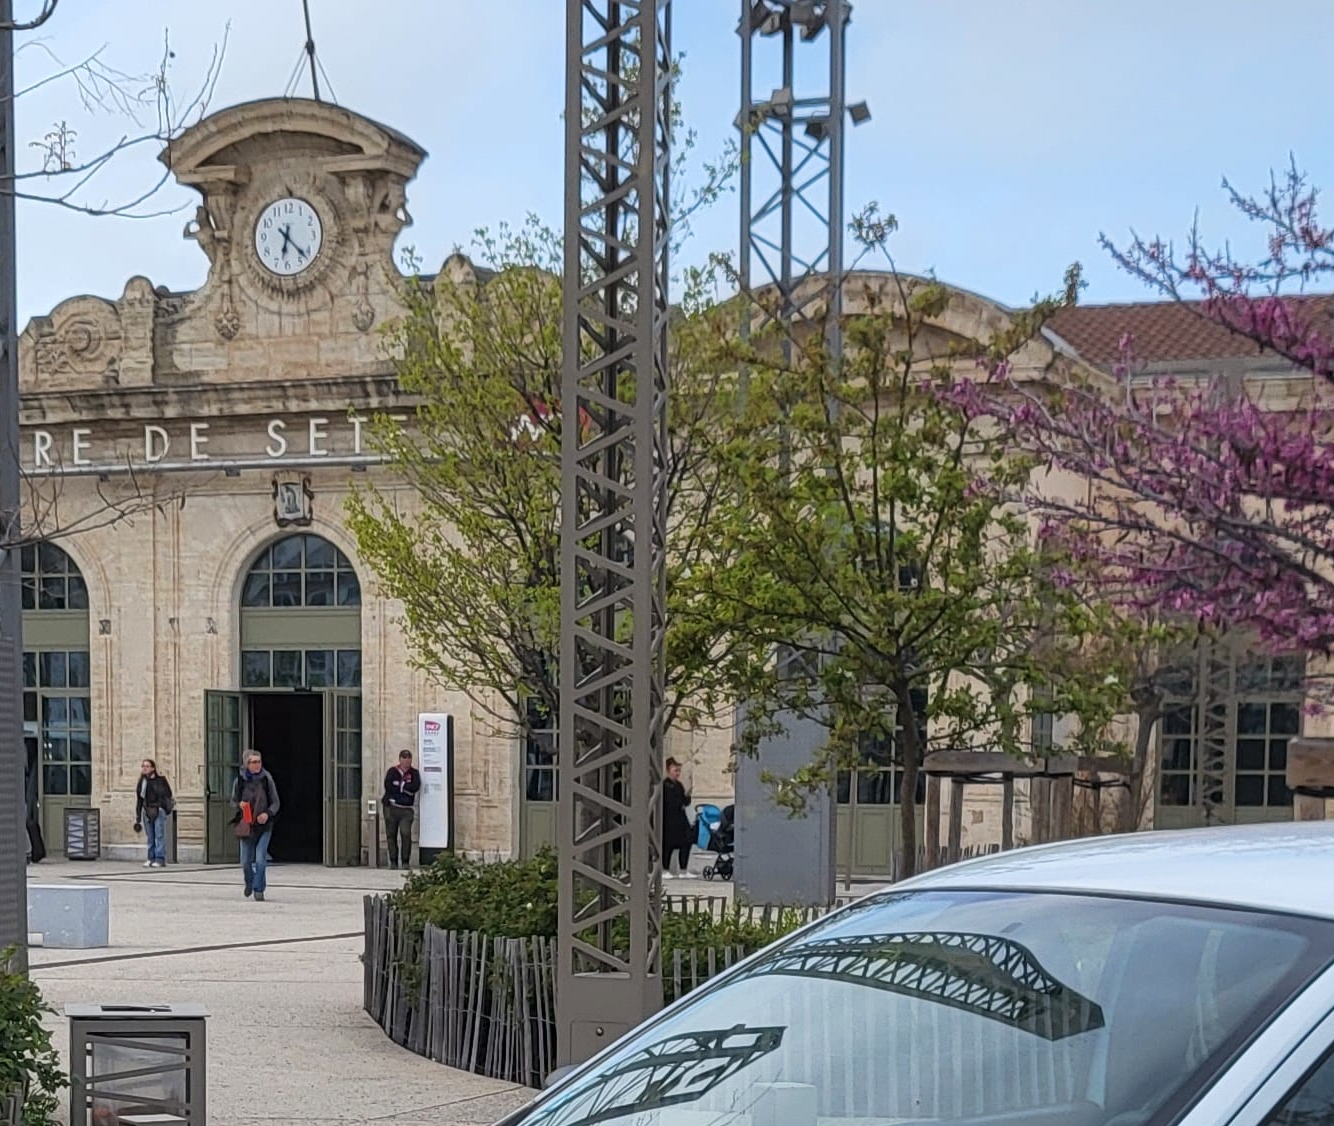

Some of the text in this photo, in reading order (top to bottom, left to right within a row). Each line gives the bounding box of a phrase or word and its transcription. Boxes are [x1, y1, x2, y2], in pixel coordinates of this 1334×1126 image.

[273, 207, 280, 217] 11
[284, 202, 294, 214] 12
[299, 205, 303, 217] 1
[263, 217, 273, 229] 10
[307, 215, 313, 227] 2
[261, 232, 267, 243] 9
[311, 230, 316, 241] 3
[263, 246, 270, 257] 8
[305, 244, 311, 257] 4
[273, 257, 279, 268] 7
[284, 260, 291, 270] 6
[297, 256, 303, 265] 5
[34, 428, 92, 466] RE
[144, 422, 210, 462] DE
